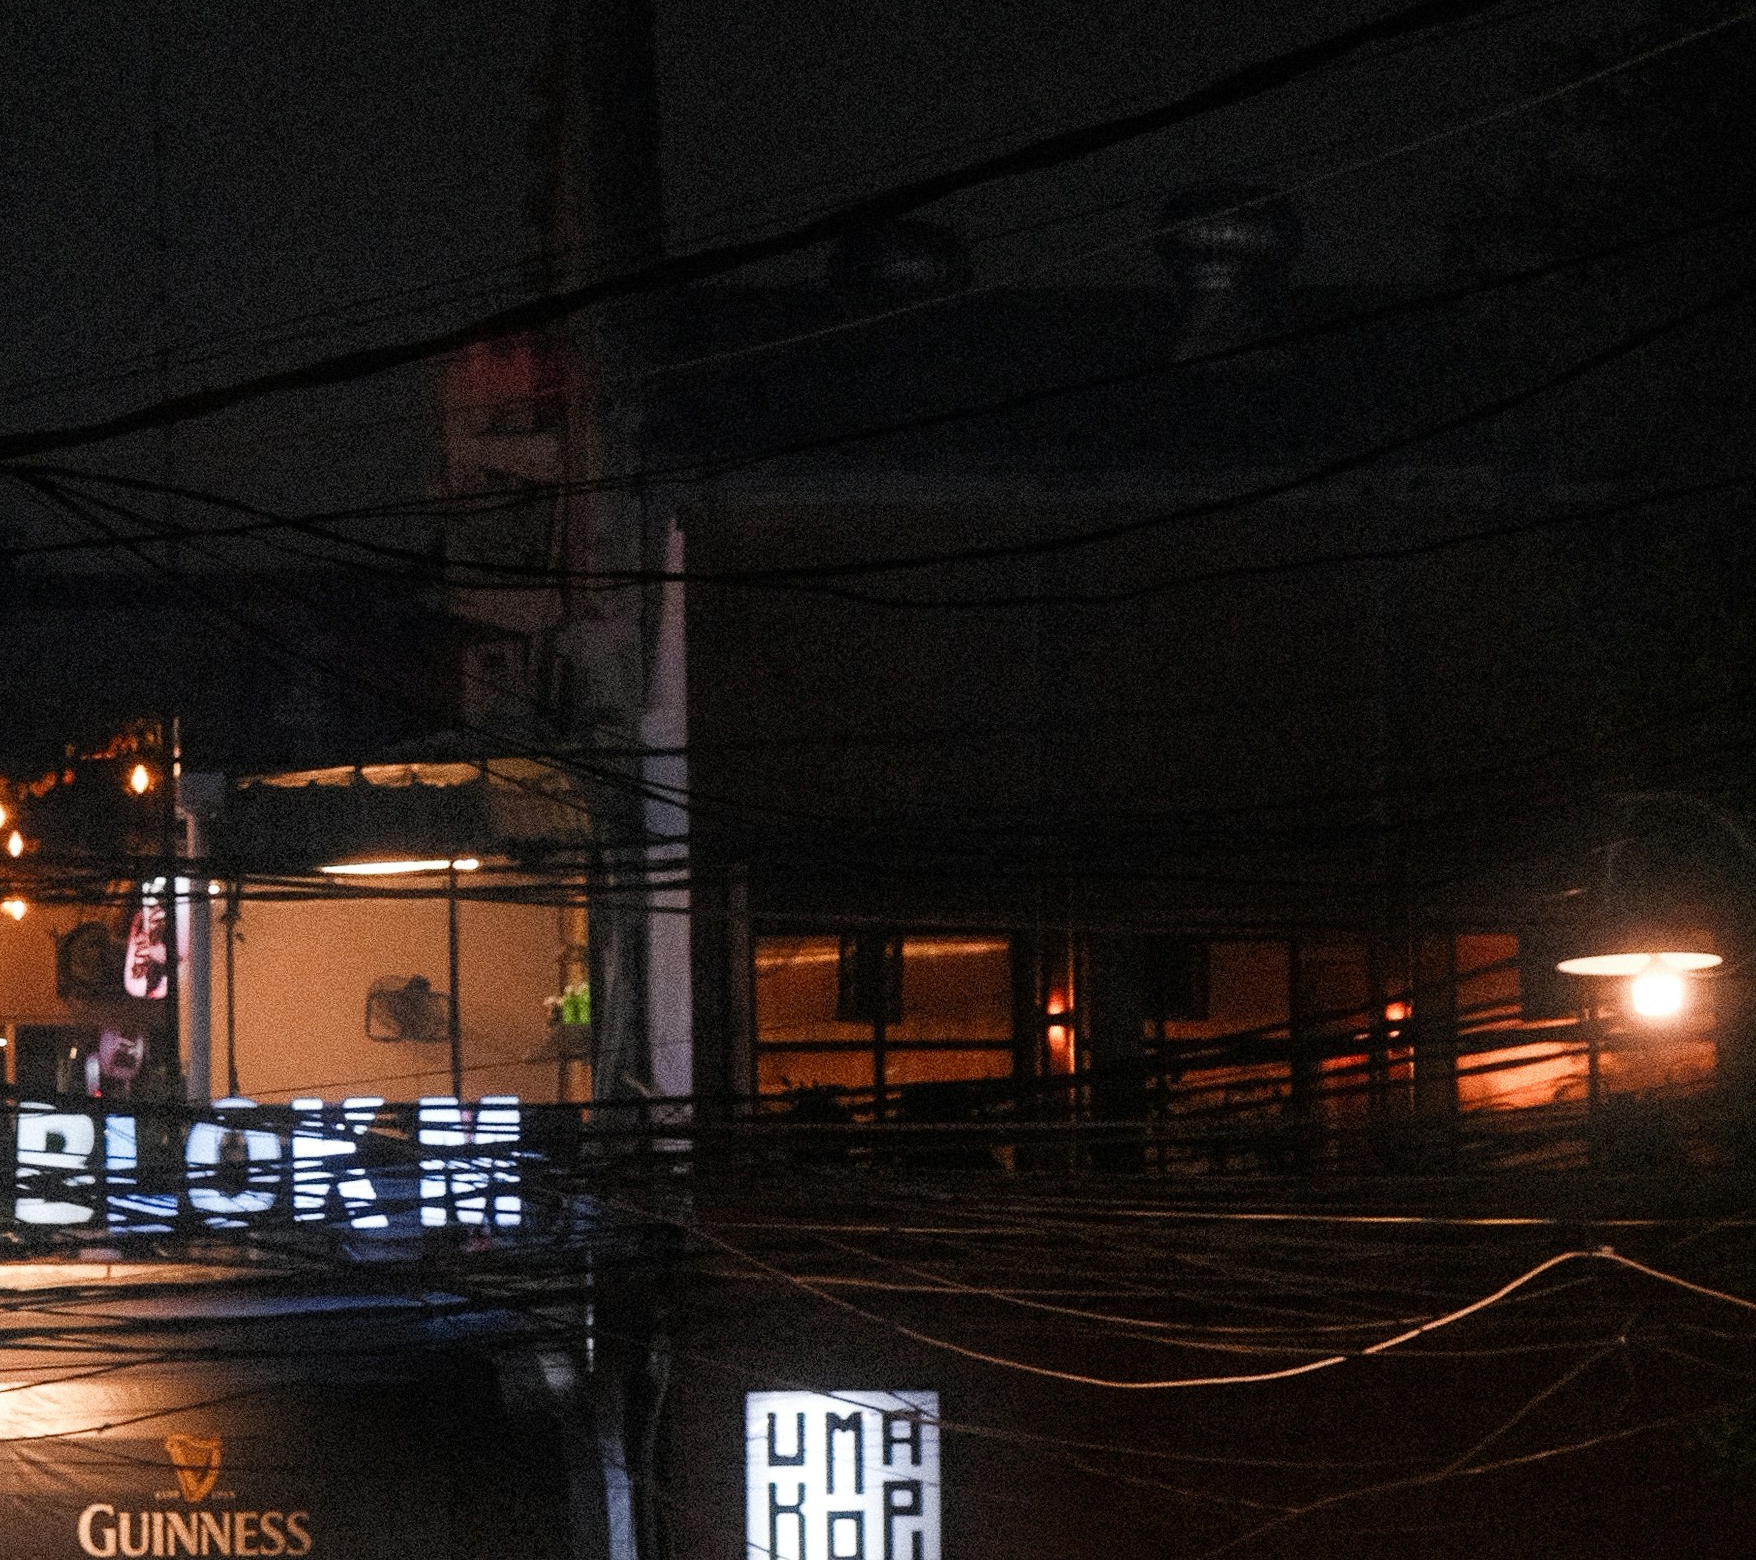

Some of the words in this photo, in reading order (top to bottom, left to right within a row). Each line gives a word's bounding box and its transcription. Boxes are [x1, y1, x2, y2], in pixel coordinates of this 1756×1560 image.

[14, 1096, 390, 1233] BLOK
[767, 1411, 922, 1495] UMA
[77, 1502, 313, 1559] GUINNESS
